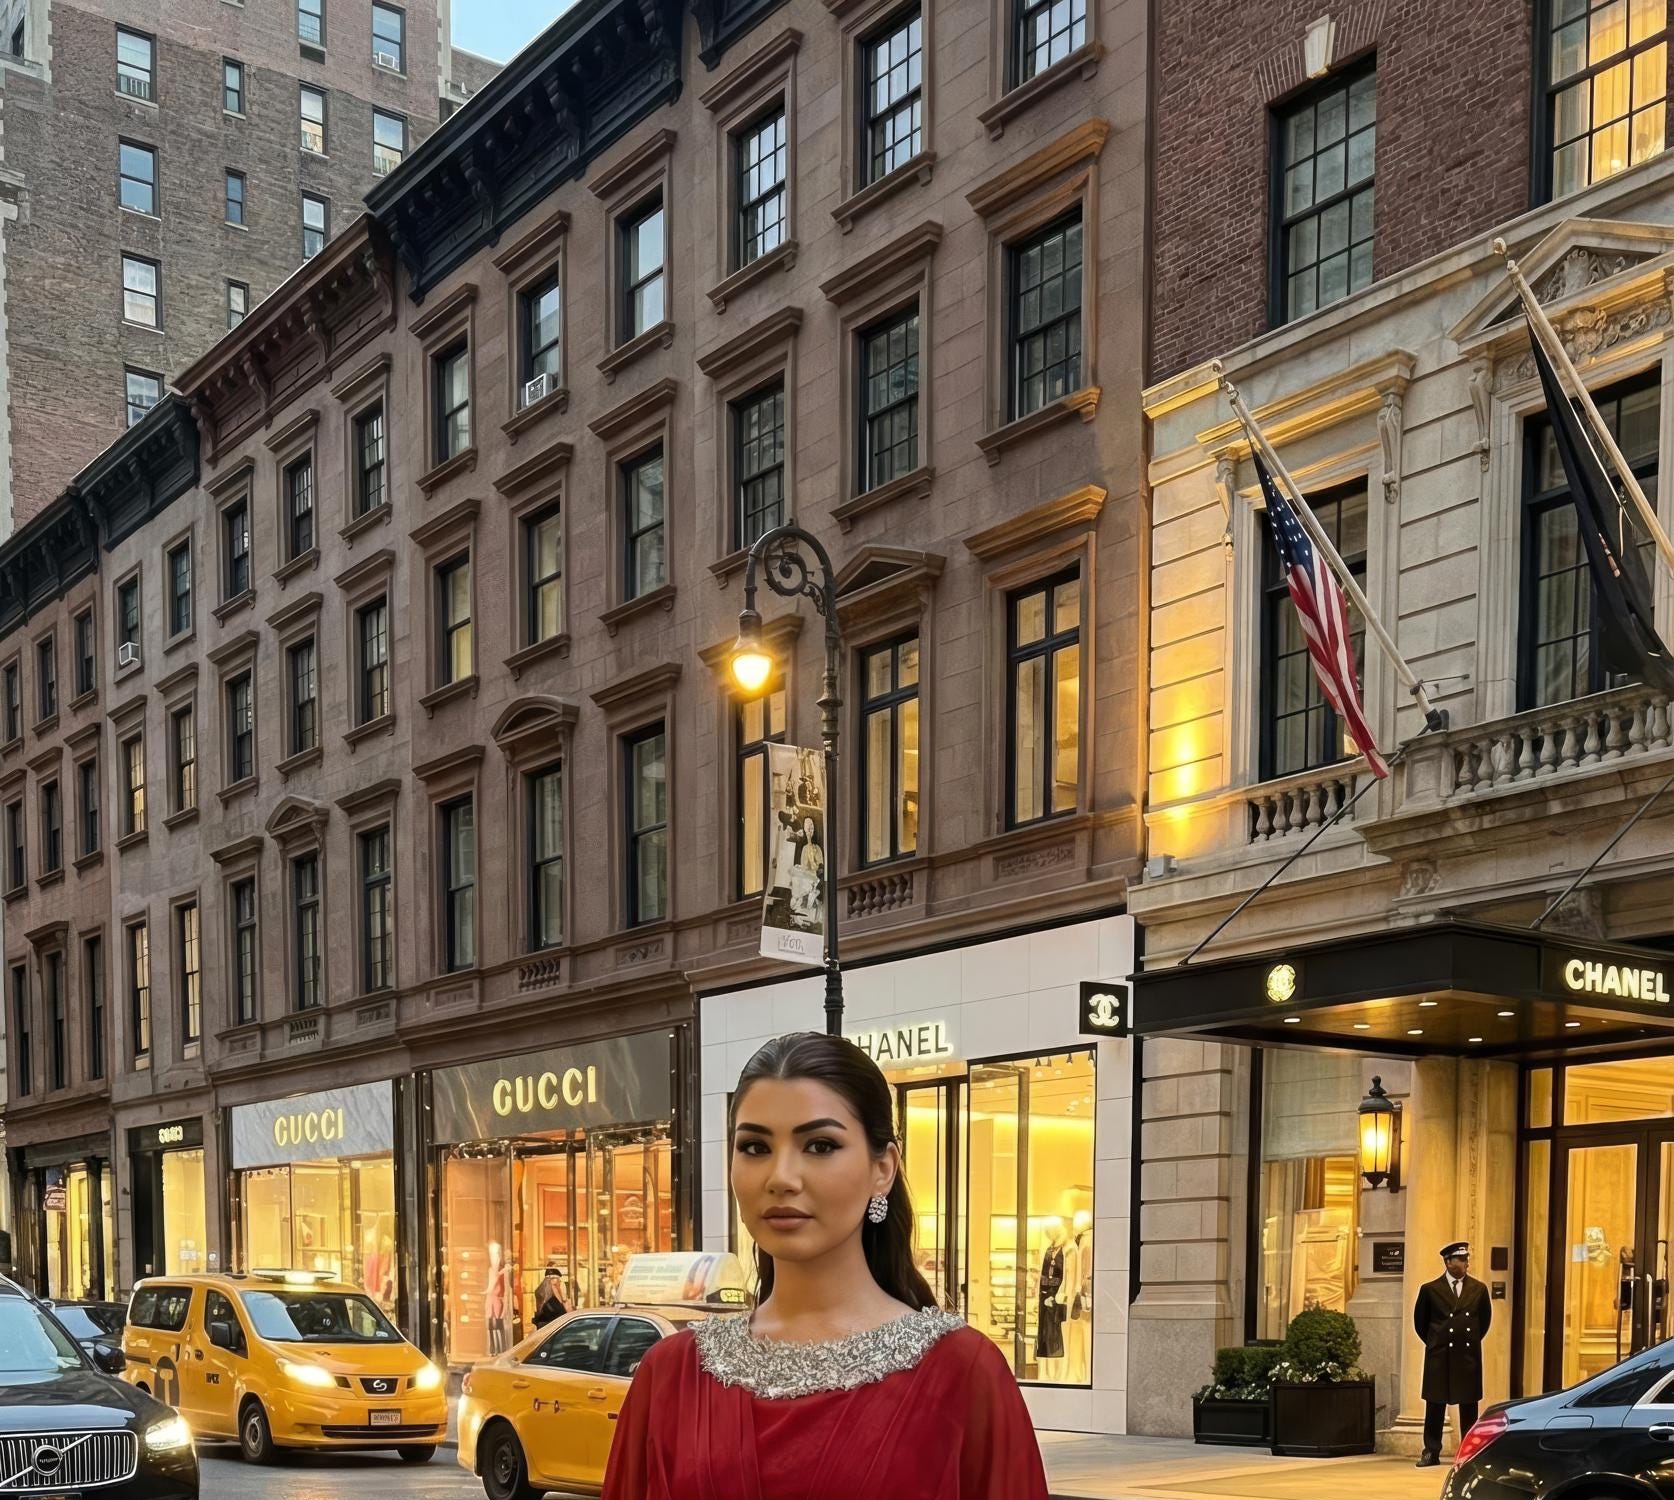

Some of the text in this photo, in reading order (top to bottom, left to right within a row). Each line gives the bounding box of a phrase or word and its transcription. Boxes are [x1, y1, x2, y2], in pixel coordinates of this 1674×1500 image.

[1565, 959, 1670, 1003] CHANEL
[857, 1024, 948, 1061] HANEL
[493, 1066, 596, 1116] GUCCI
[274, 1108, 344, 1146] GUCCI
